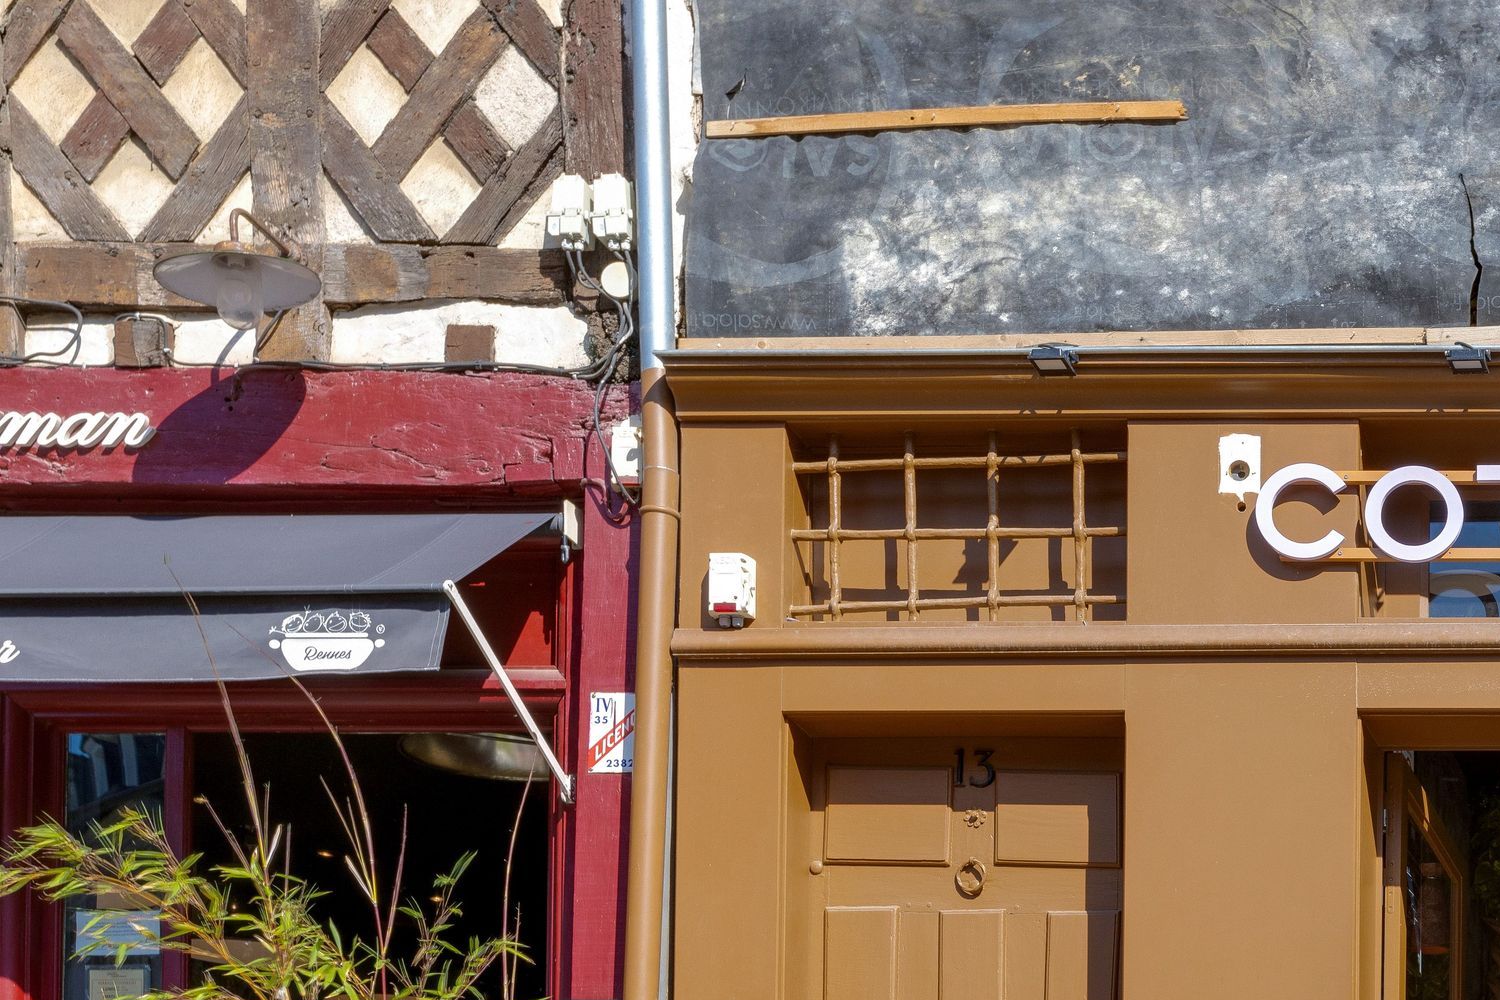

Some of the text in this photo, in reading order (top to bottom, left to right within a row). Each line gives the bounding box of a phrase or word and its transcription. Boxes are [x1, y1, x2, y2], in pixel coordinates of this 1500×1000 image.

[0, 411, 157, 448] man
[304, 646, 352, 661] Rennes
[594, 716, 608, 724] 35
[953, 747, 996, 789] 13
